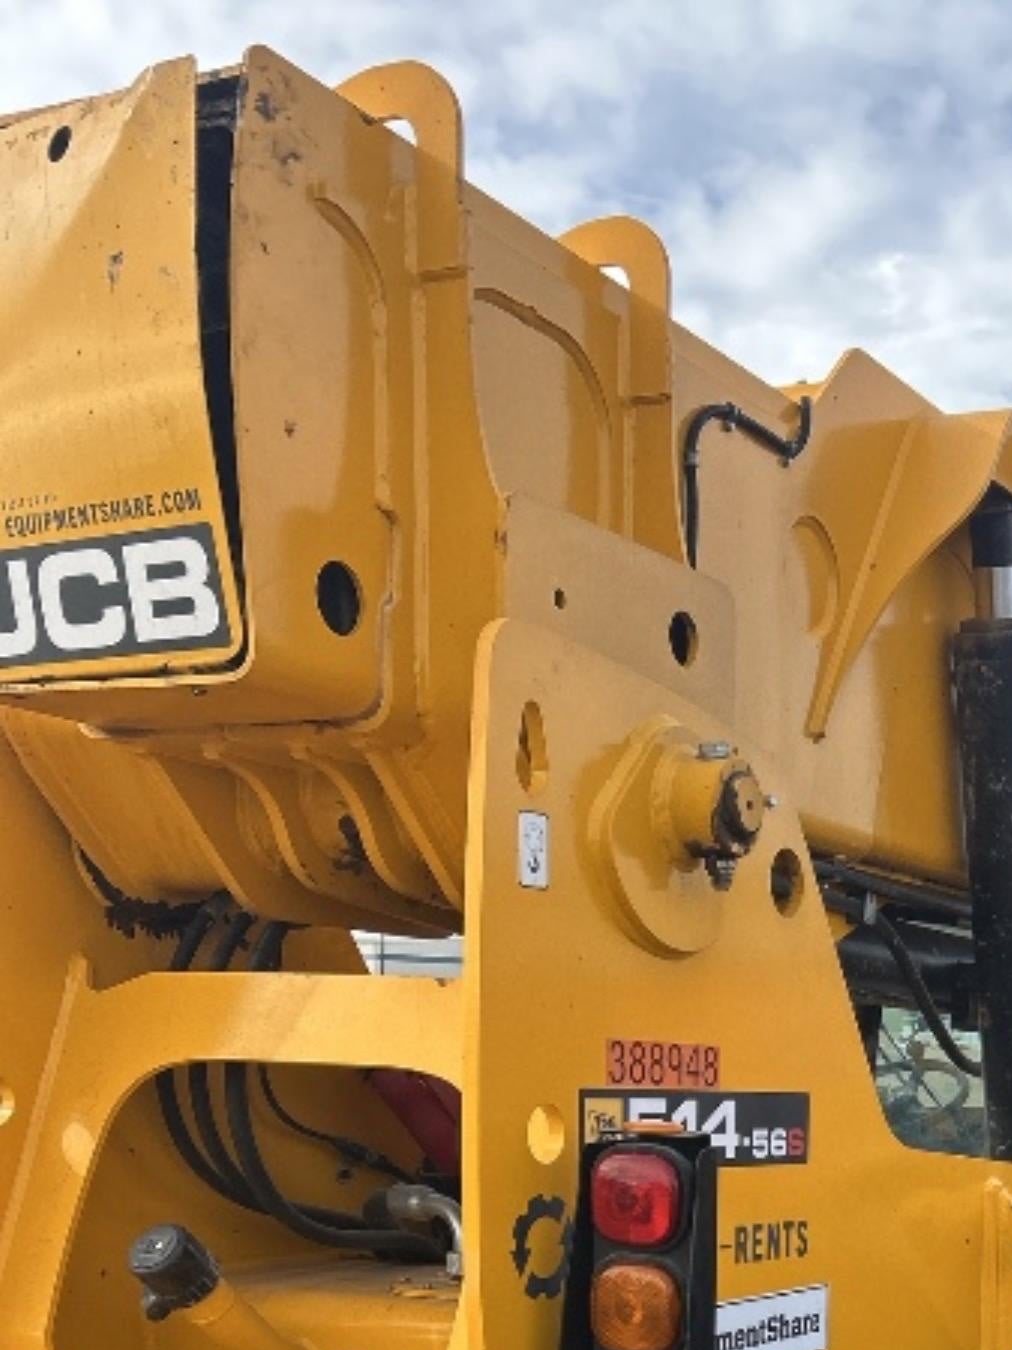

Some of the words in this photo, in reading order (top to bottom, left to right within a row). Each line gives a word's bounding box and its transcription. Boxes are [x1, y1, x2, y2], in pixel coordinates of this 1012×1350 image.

[5, 488, 202, 537] EQUIPMENTSHARE.COM
[0, 537, 220, 658] JCB
[609, 1041, 718, 1086] 388948
